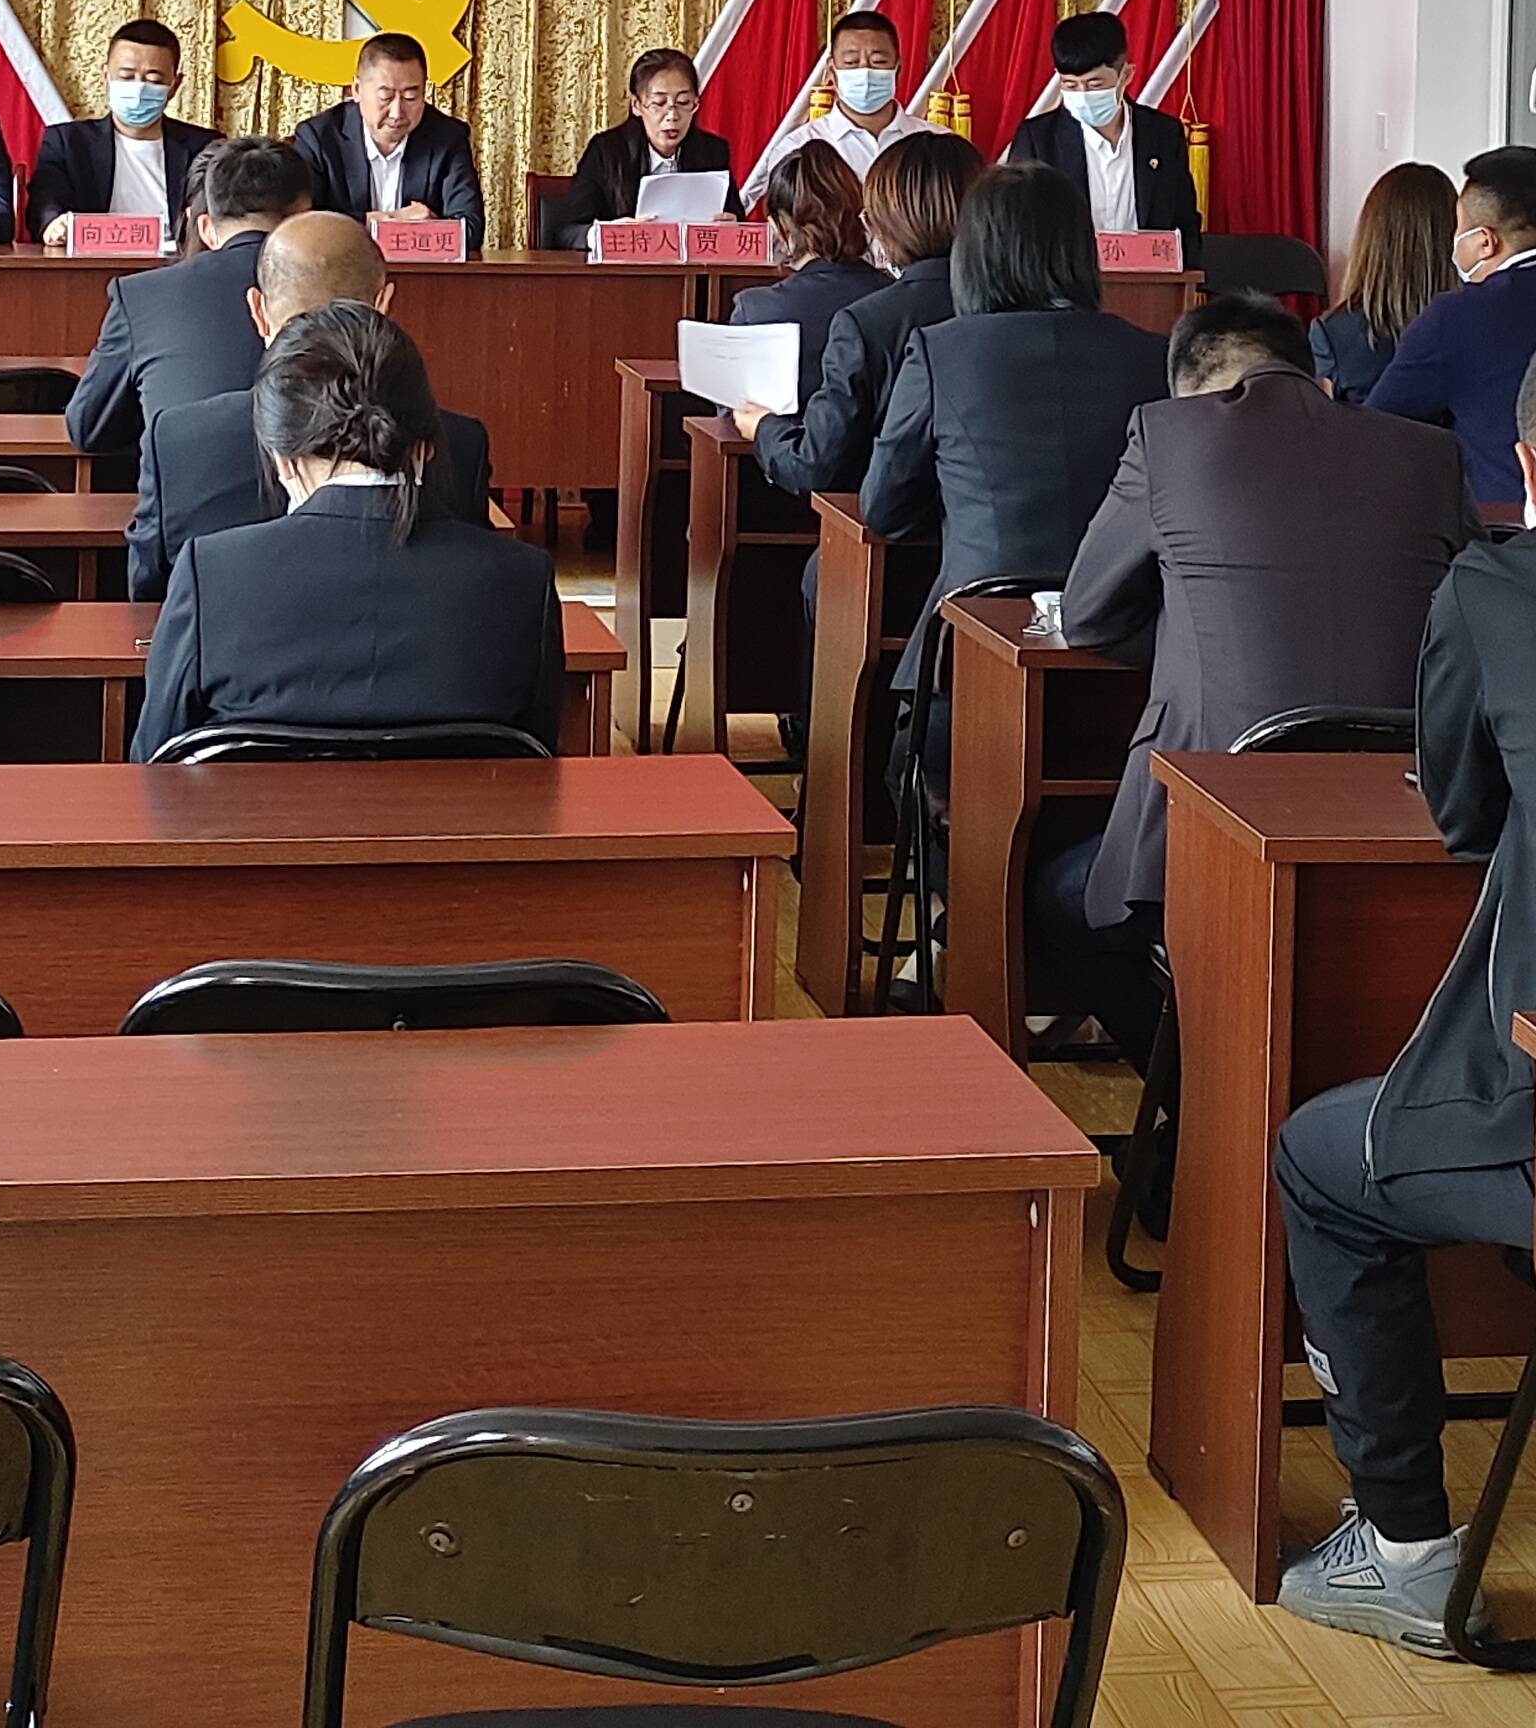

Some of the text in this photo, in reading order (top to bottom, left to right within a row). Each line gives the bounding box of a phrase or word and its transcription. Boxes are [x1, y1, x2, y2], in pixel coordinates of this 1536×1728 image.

[82, 223, 154, 245] 向立凯
[605, 229, 678, 254] 主持人
